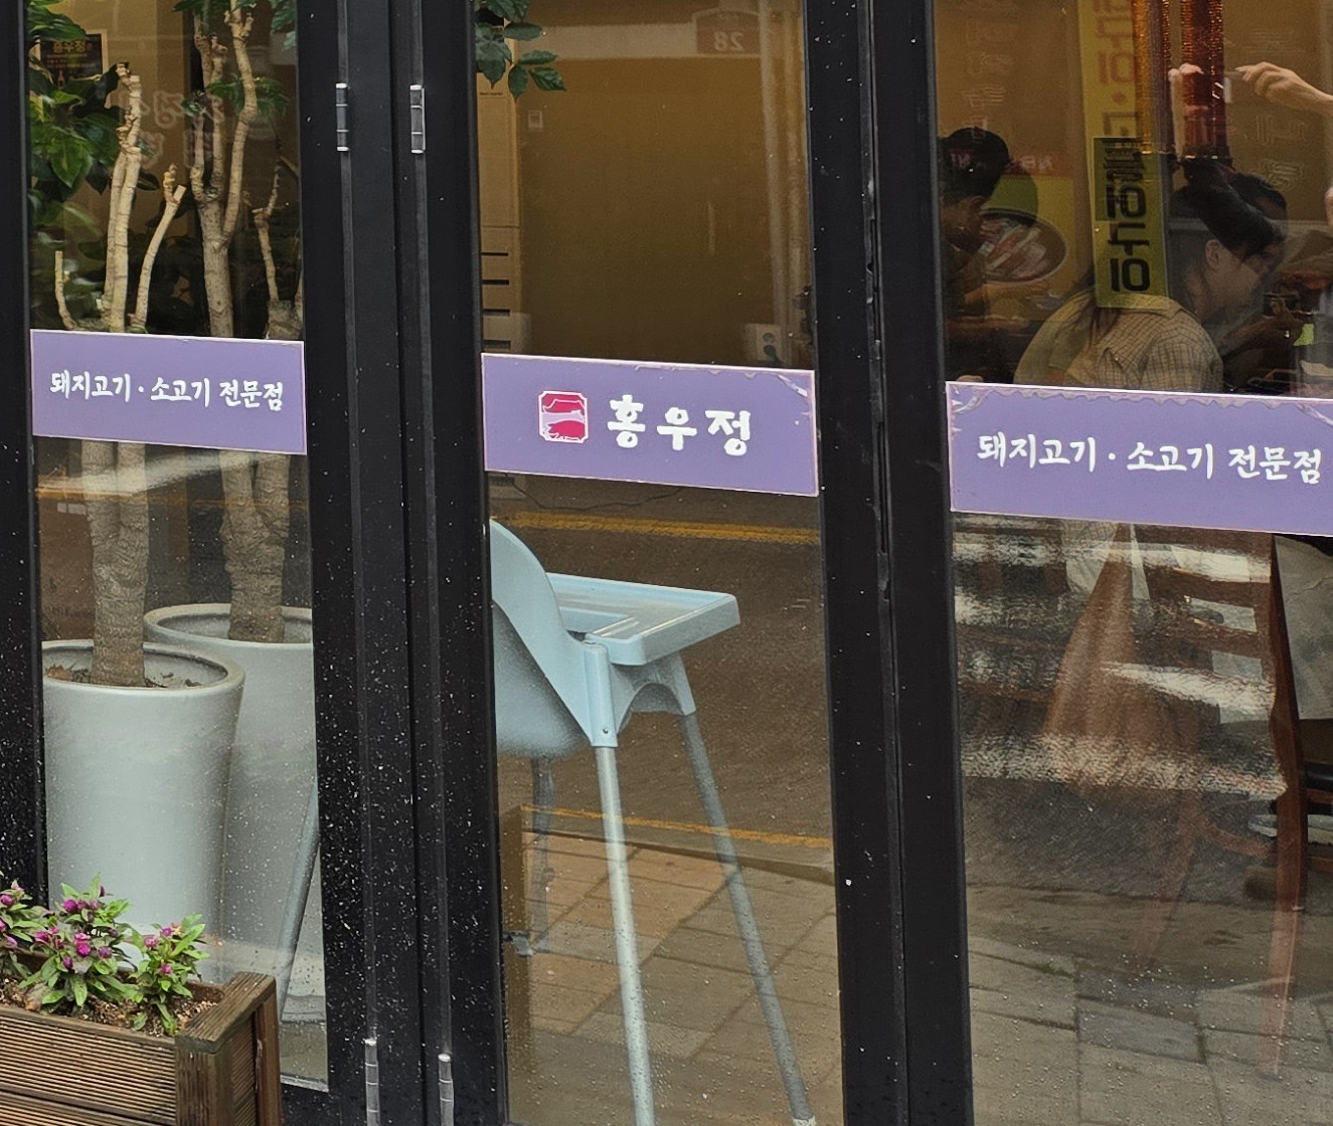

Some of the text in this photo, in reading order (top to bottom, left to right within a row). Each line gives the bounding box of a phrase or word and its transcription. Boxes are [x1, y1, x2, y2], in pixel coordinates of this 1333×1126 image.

[219, 379, 284, 412] 전문점
[606, 394, 753, 457] 홍우정
[1228, 444, 1322, 485] 전문점
